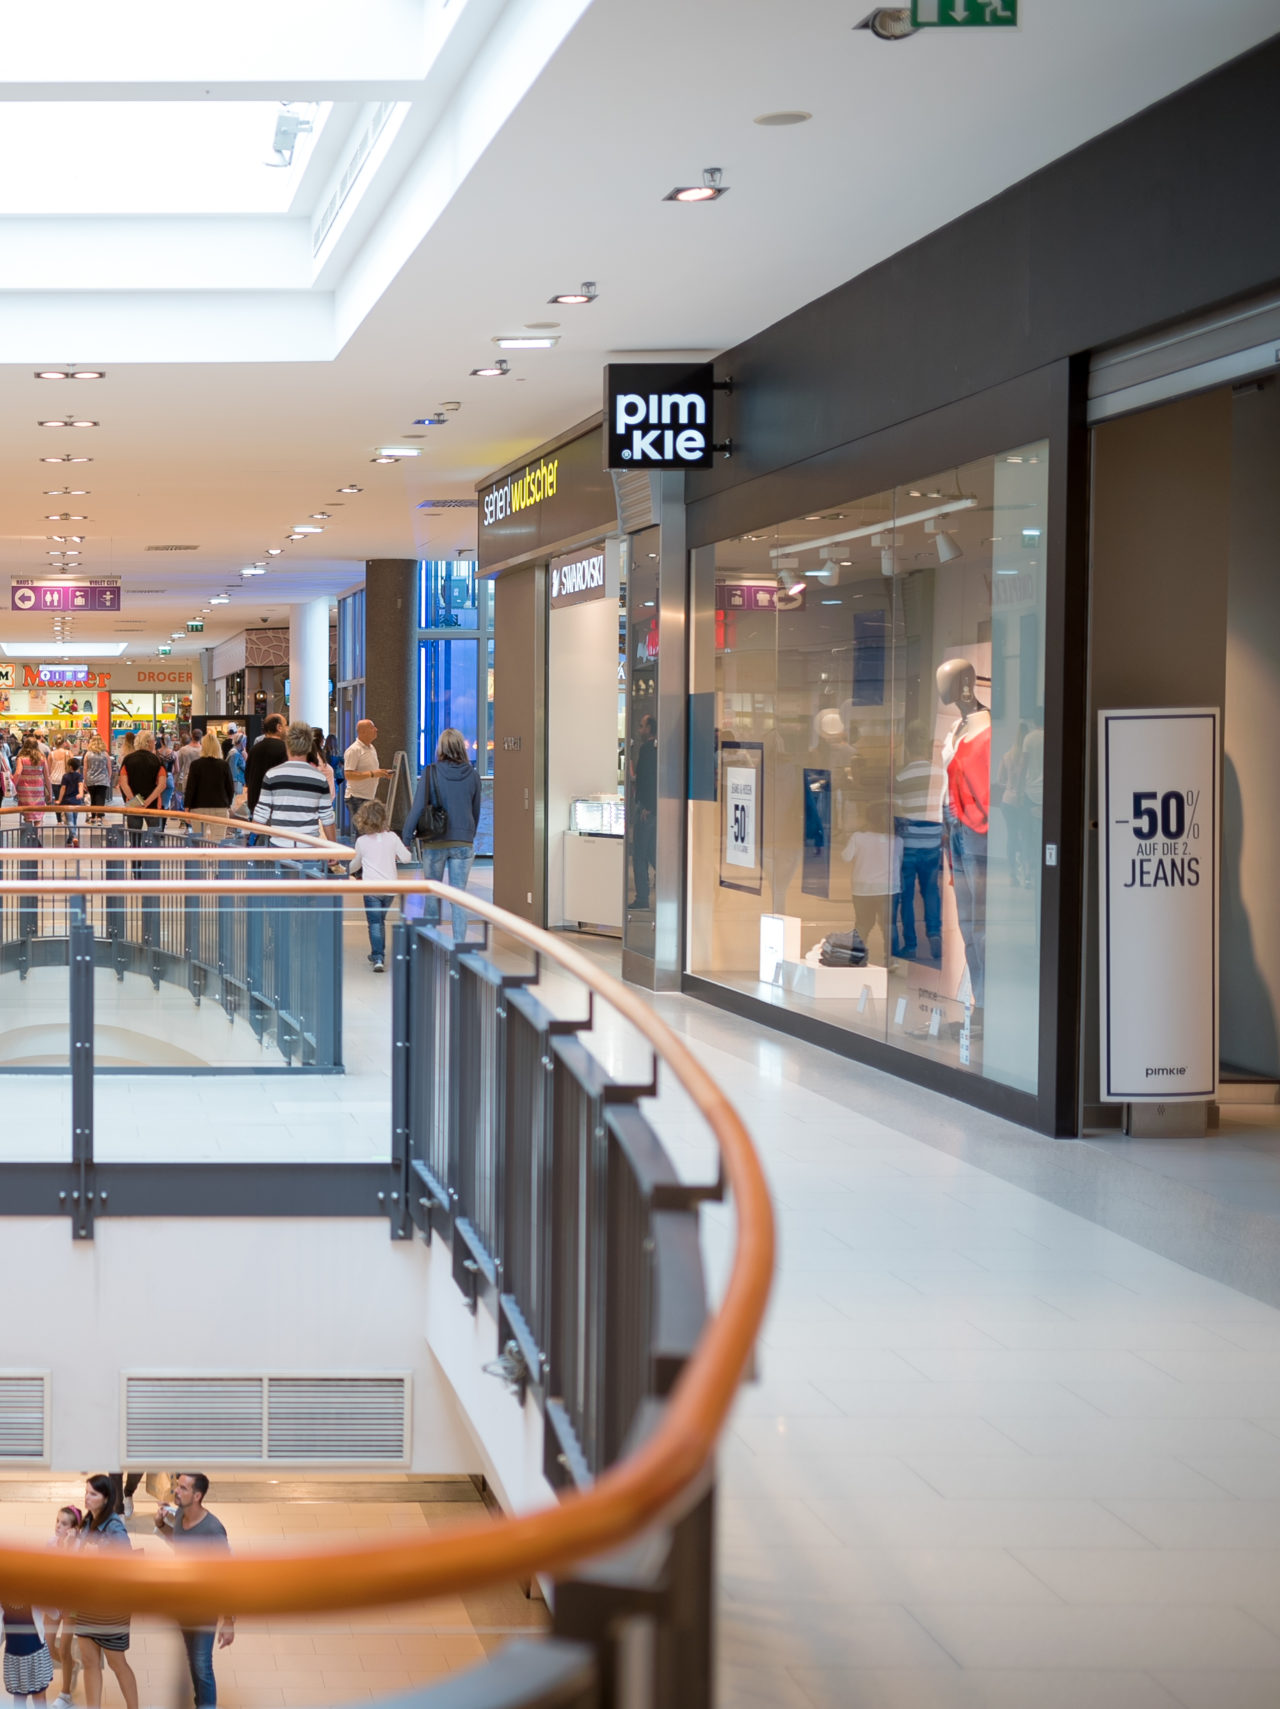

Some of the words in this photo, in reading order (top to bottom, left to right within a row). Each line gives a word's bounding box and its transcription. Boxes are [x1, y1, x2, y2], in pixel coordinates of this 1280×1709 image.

[616, 393, 706, 434] pim
[561, 555, 604, 595] SWAROVSKI
[1114, 790, 1201, 841] -50%
[1136, 842, 1159, 856] AUF
[1162, 842, 1179, 856] DIE
[1182, 842, 1192, 855] 2.
[1123, 857, 1200, 888] JEANS
[1145, 1066, 1187, 1078] pimkie
